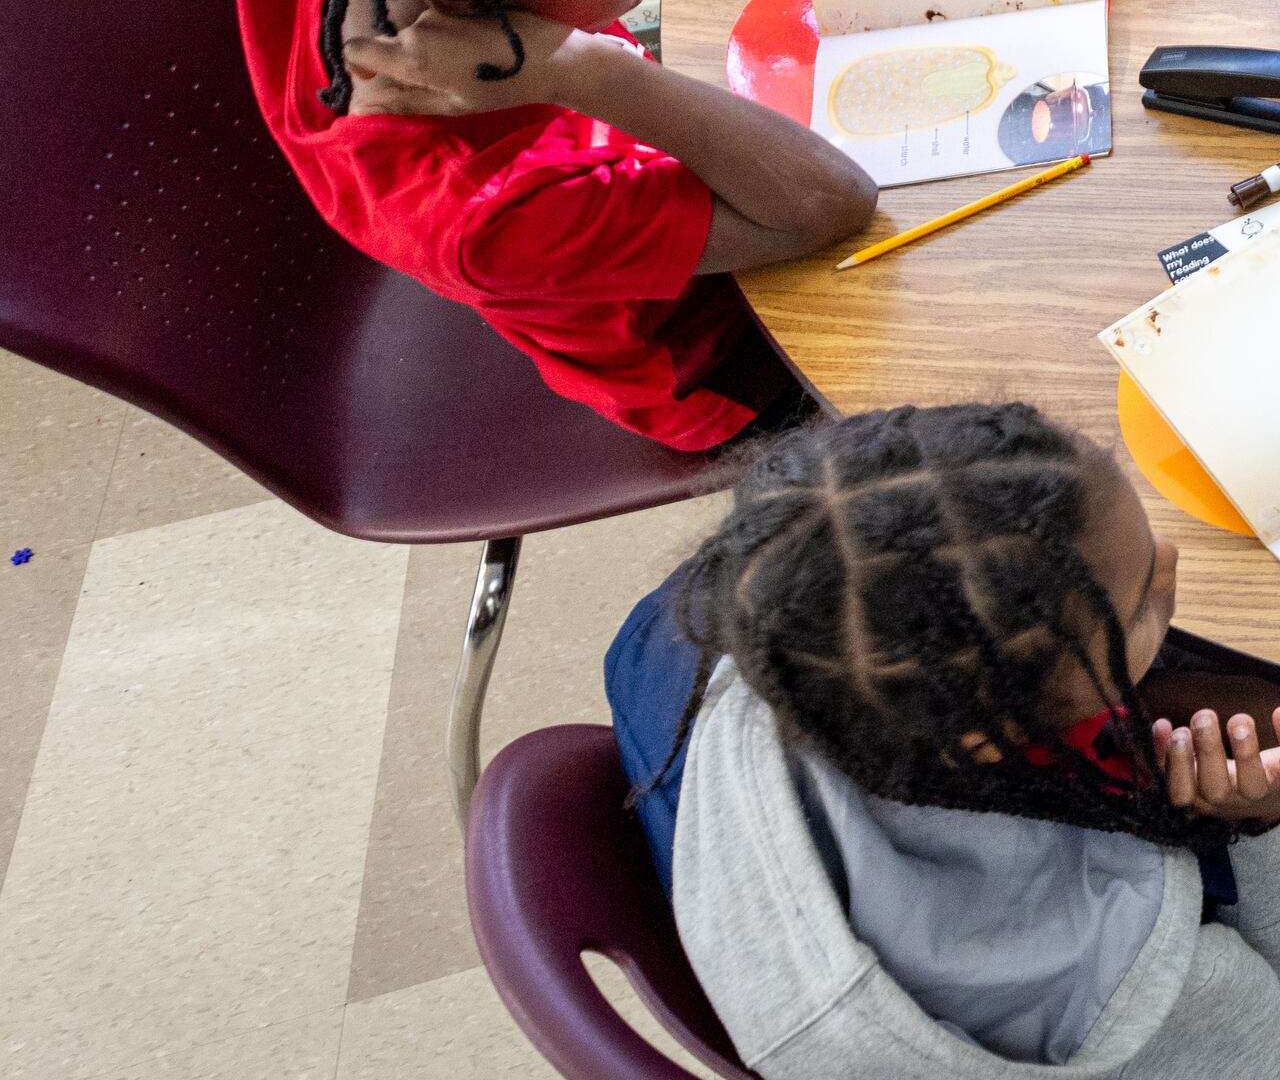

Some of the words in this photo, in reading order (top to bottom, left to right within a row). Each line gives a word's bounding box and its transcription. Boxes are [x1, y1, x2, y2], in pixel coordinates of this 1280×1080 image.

[1162, 246, 1189, 263] What
[1191, 236, 1214, 250] does
[1167, 258, 1183, 271] my
[1170, 256, 1209, 278] reading
